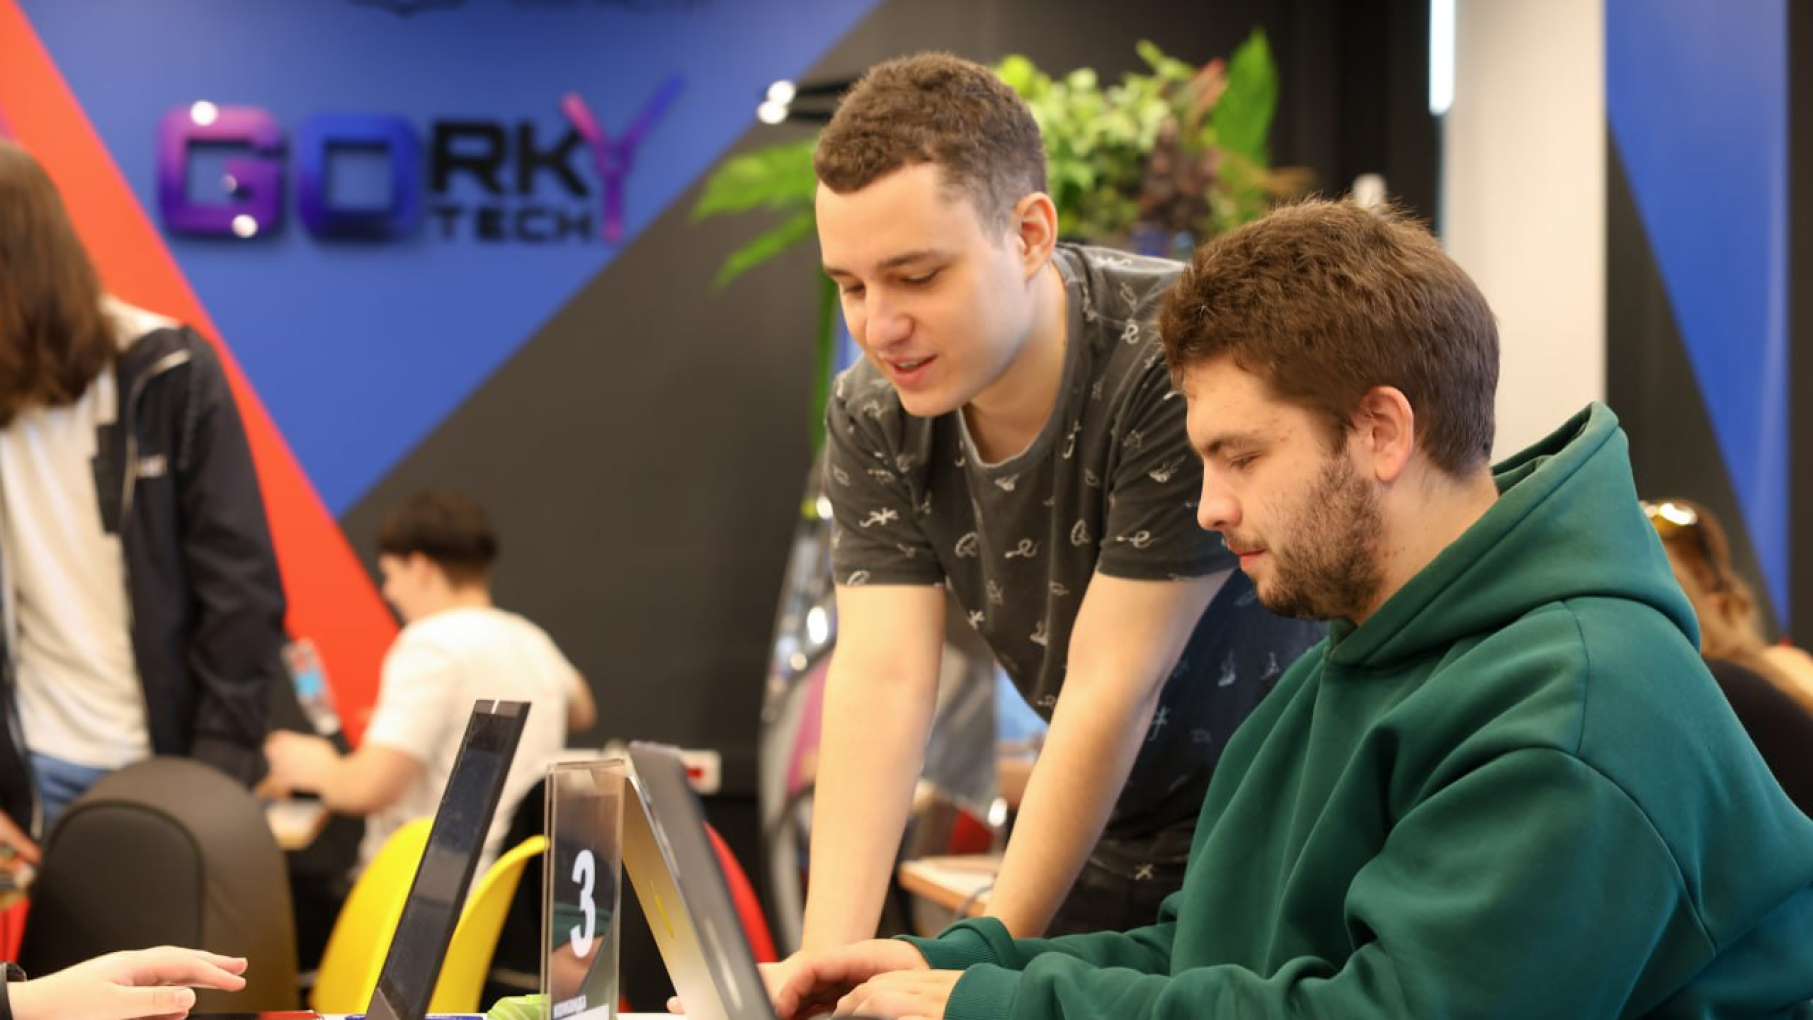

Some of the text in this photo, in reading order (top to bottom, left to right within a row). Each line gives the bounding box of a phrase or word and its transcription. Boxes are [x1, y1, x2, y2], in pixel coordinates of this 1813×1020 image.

[157, 75, 685, 241] GORKY
[431, 207, 593, 242] TECH
[570, 849, 596, 959] 3
